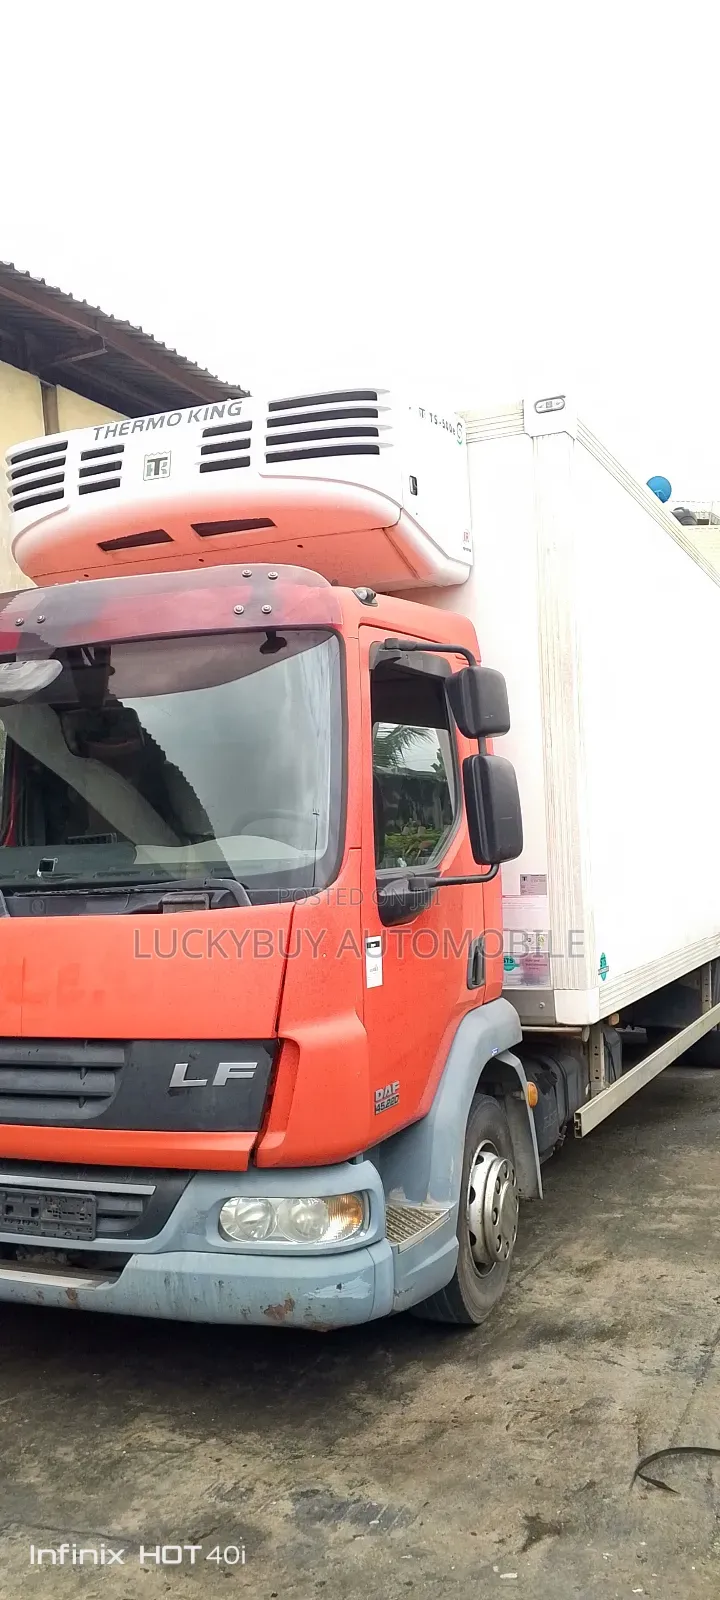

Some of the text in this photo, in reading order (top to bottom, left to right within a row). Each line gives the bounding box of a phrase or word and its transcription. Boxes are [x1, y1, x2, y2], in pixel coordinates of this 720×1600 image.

[93, 401, 243, 441] THERMO KING
[169, 1062, 258, 1088] LF
[375, 1080, 400, 1102] DAF
